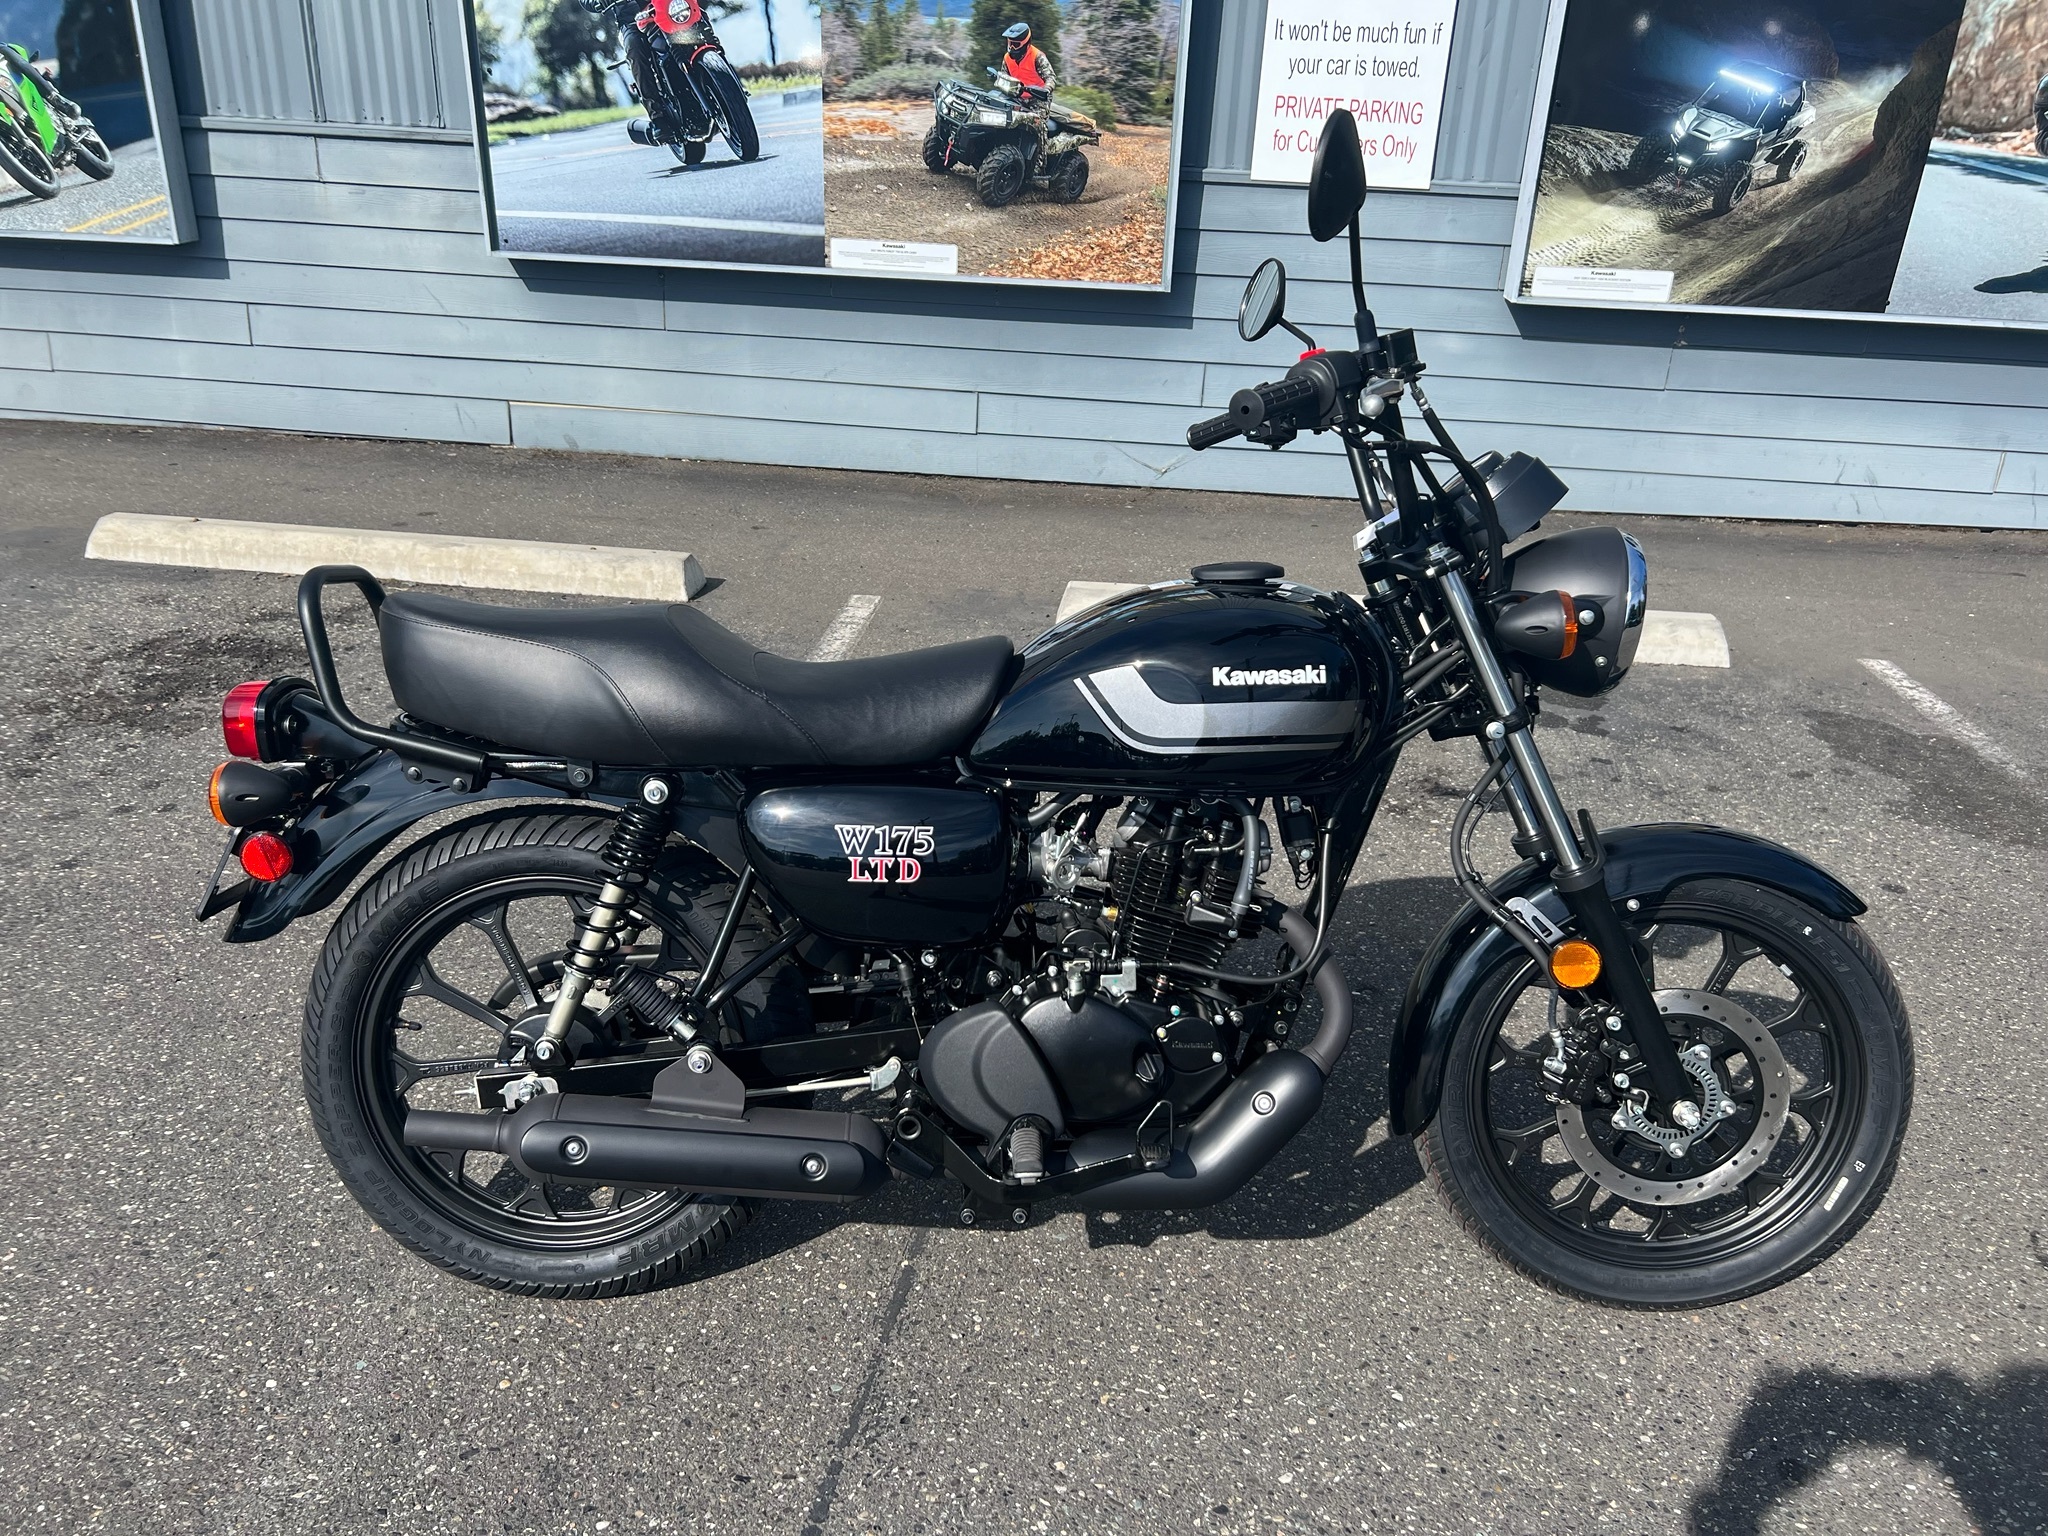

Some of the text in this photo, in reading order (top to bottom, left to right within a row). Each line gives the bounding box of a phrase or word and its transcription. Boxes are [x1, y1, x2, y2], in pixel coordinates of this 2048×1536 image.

[1275, 18, 1443, 45] It won't be much fun if
[1288, 54, 1420, 80] your car is towed.
[1350, 99, 1423, 124] PARKING
[1273, 129, 1293, 151] for
[1383, 134, 1417, 164] Only
[1212, 664, 1327, 686] Kawasaki
[834, 824, 935, 856] W175
[847, 856, 921, 883] LTD
[368, 877, 440, 947] MRF
[618, 1212, 697, 1268] MRF
